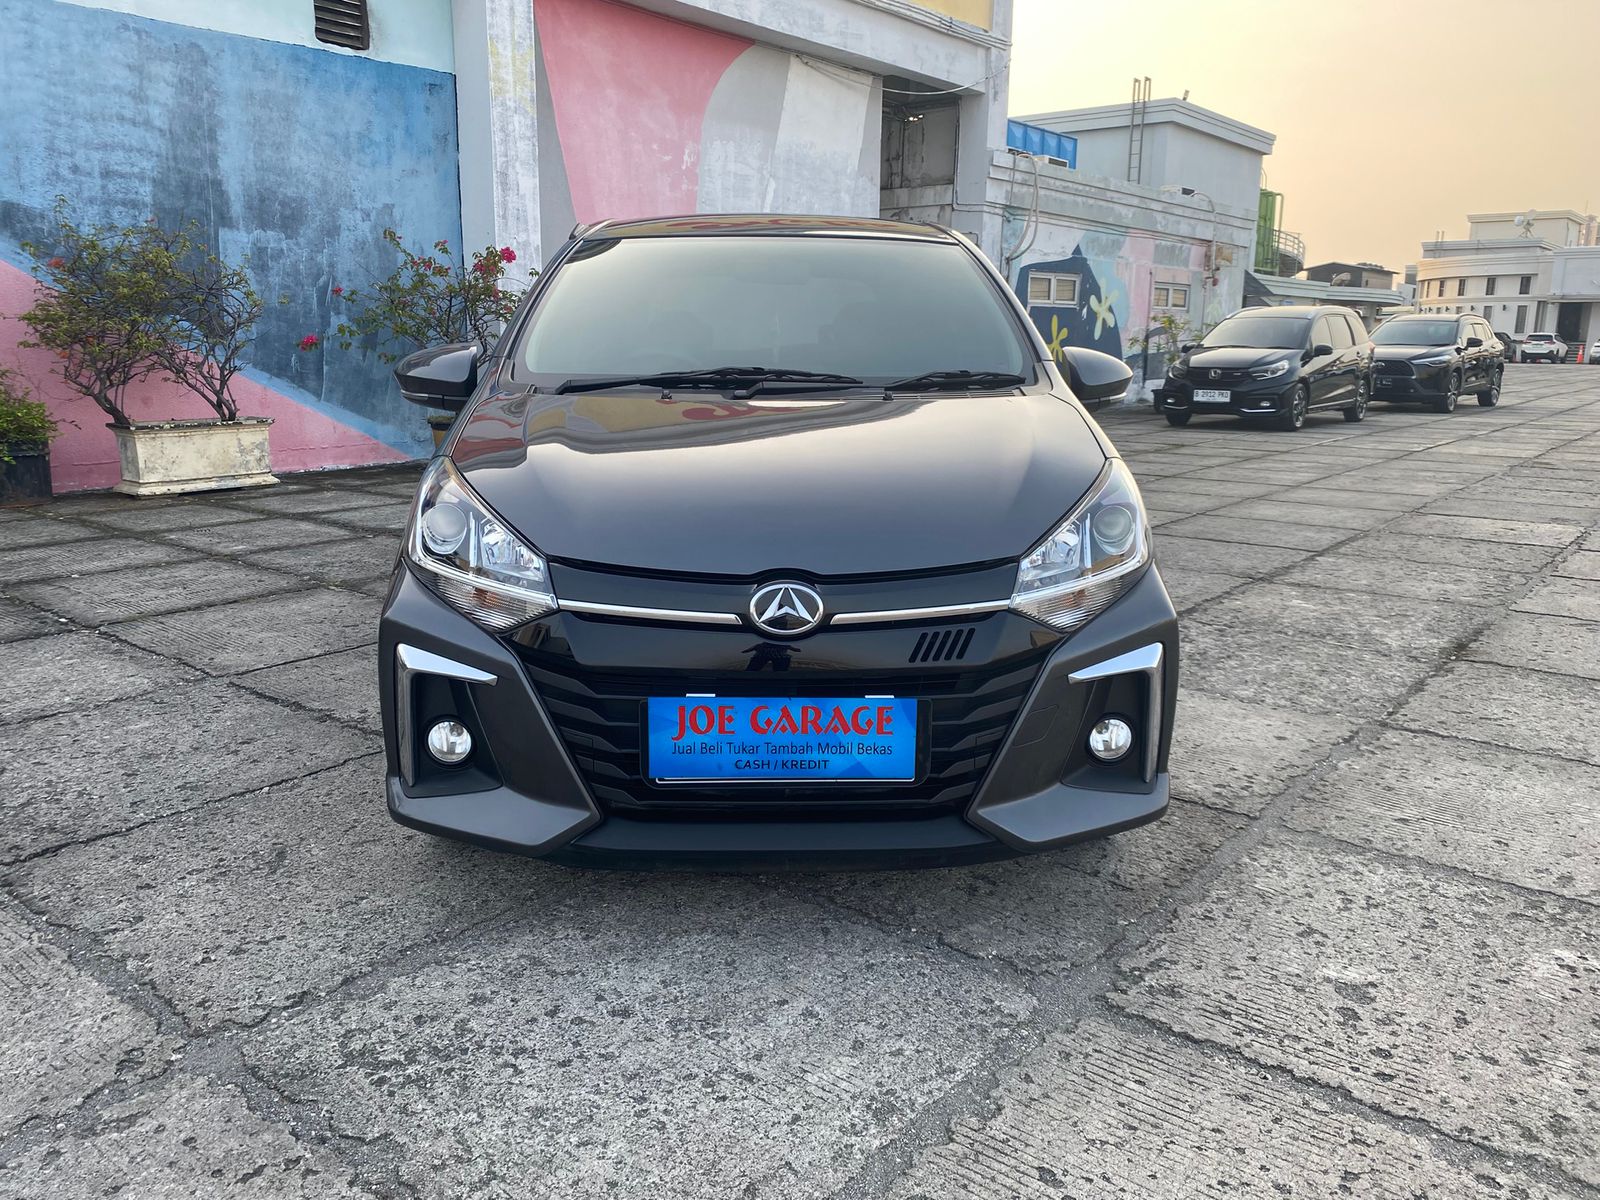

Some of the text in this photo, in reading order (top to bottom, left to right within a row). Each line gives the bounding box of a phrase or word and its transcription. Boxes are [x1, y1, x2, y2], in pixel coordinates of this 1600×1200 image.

[671, 705, 894, 741] JOE GARAGE
[672, 741, 892, 756] Jual Beli Tukar Tambah Mobil Bekas
